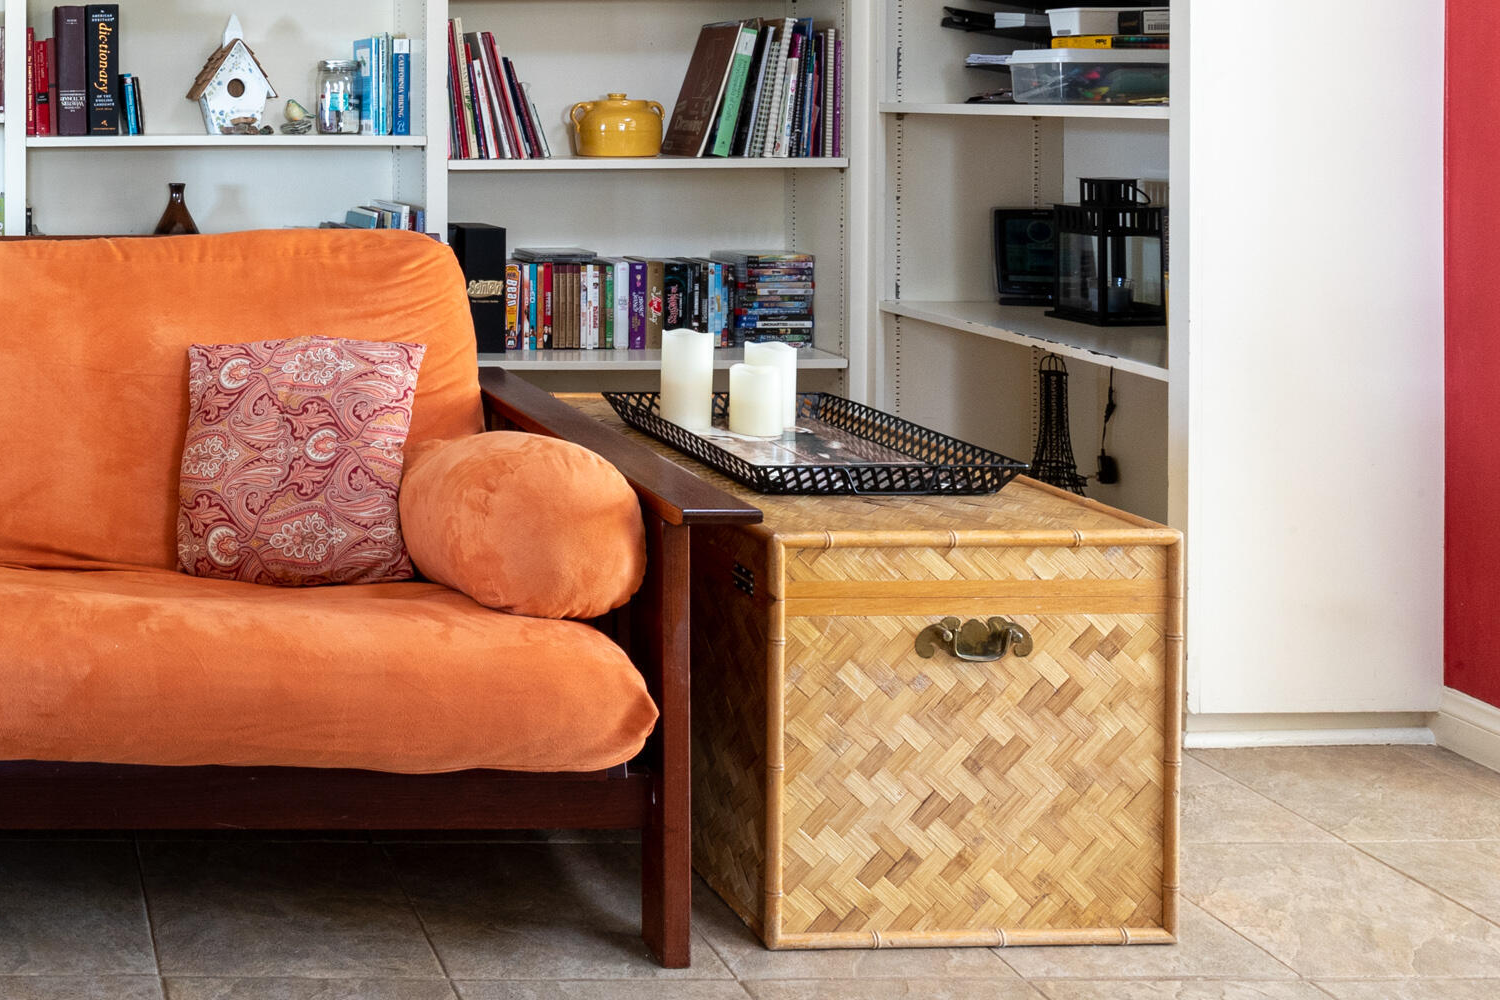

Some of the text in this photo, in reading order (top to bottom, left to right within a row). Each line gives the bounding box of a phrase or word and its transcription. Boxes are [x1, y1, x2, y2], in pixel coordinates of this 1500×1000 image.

[676, 113, 703, 135] Drawing
[649, 294, 662, 324] Love Lucy
